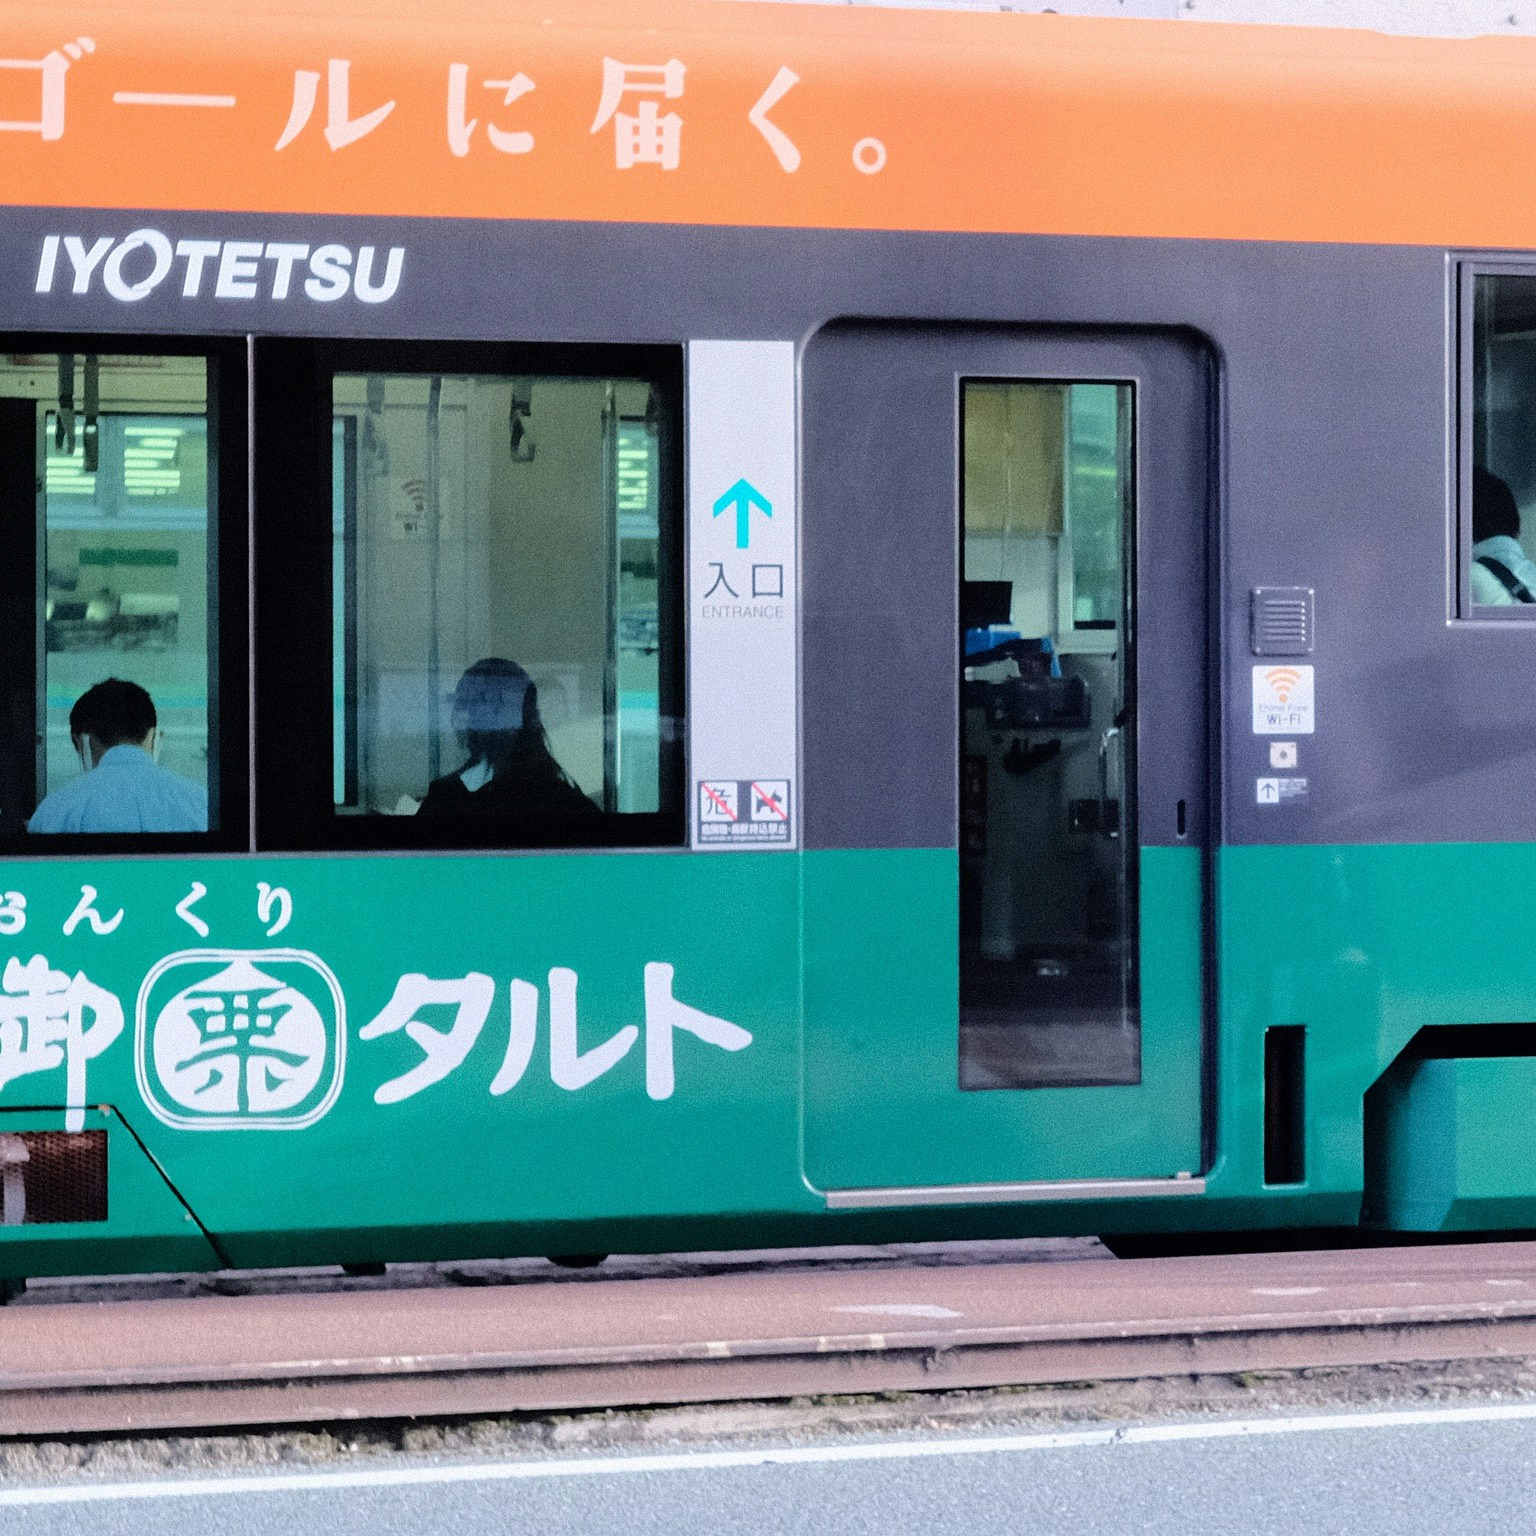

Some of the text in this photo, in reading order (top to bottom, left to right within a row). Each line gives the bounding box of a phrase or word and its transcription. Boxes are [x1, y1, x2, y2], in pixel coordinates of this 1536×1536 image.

[0, 36, 887, 174] ゴールに届く。
[35, 228, 406, 304] IYOTETSU
[704, 562, 784, 599] 入口
[701, 605, 785, 620] ENTRANCE
[1266, 713, 1301, 726] Wi-Fi
